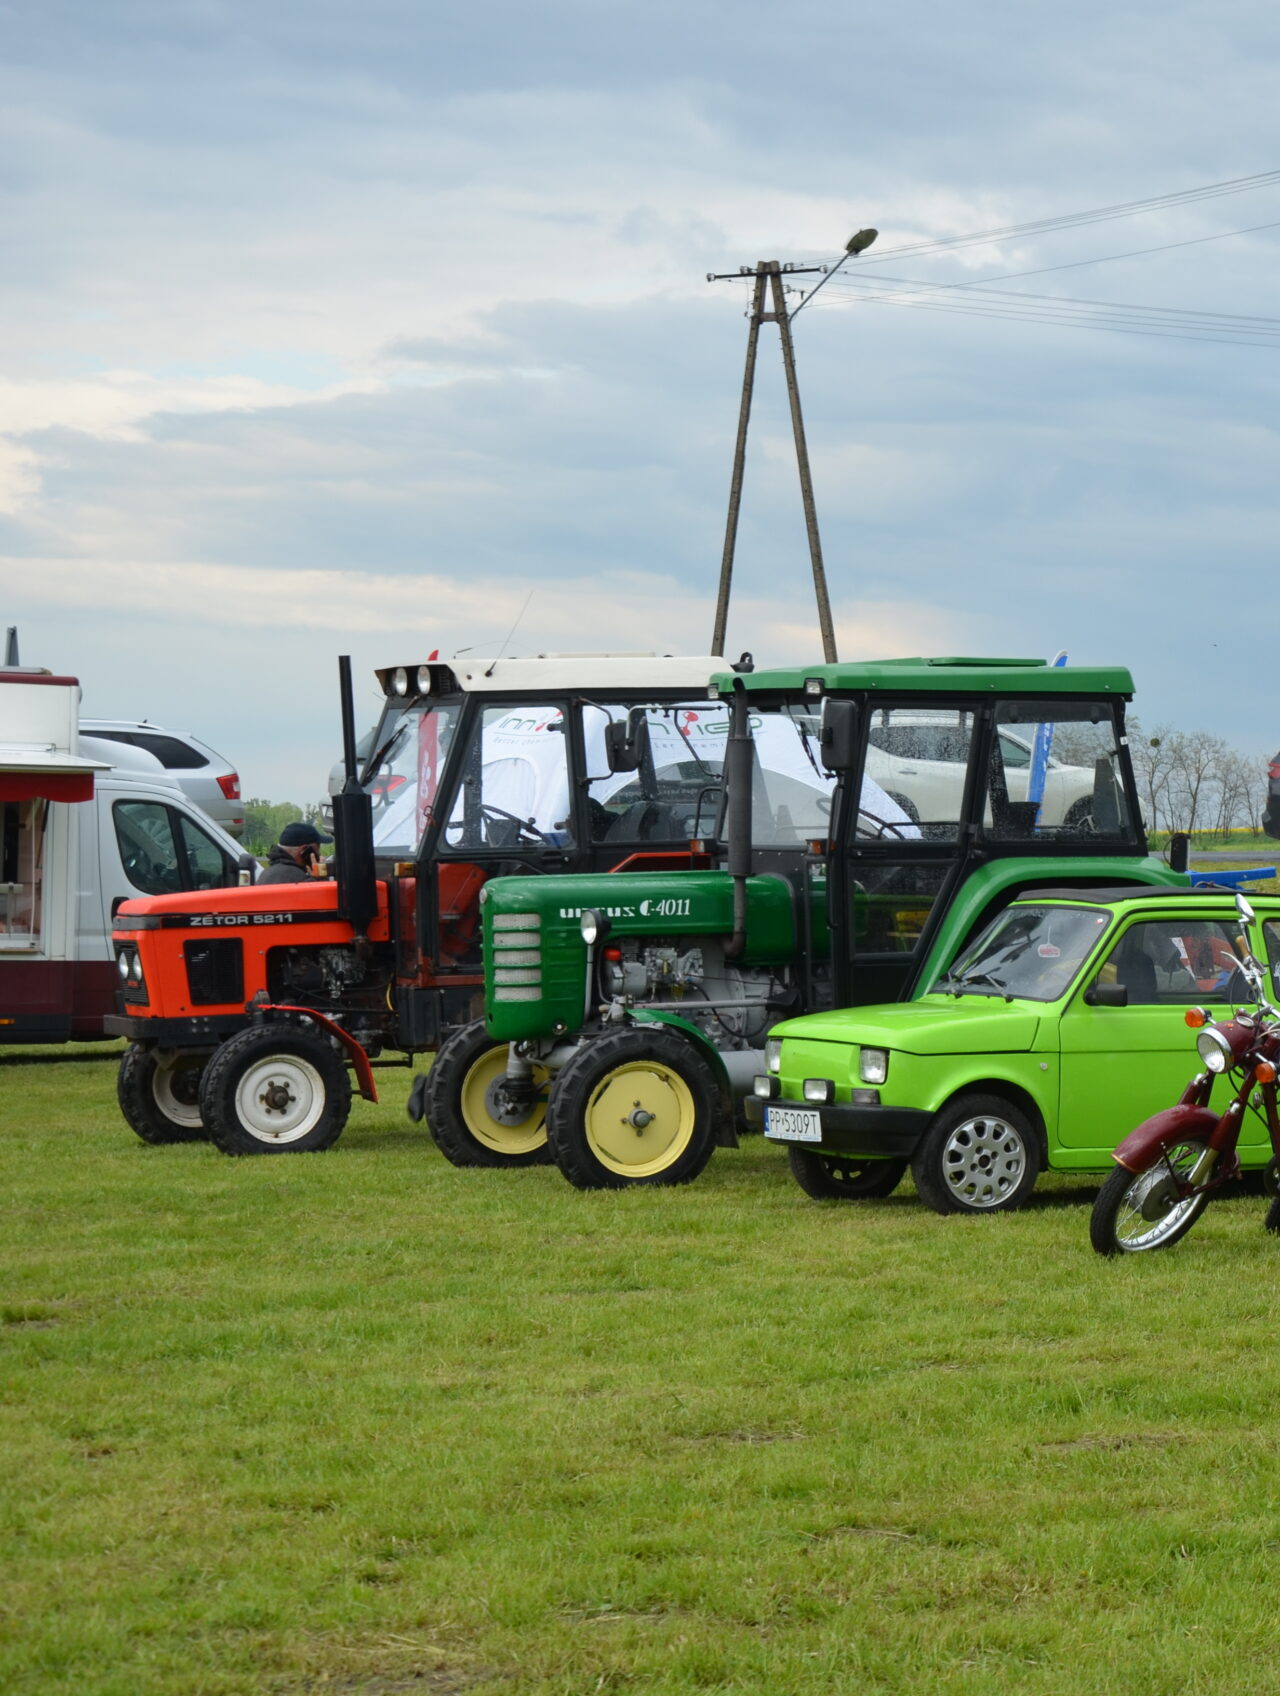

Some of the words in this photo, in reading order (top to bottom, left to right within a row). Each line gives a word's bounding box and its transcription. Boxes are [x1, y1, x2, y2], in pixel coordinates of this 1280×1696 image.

[639, 898, 691, 916] C-4011
[190, 916, 249, 926] ZETOR
[253, 913, 293, 924] 5211
